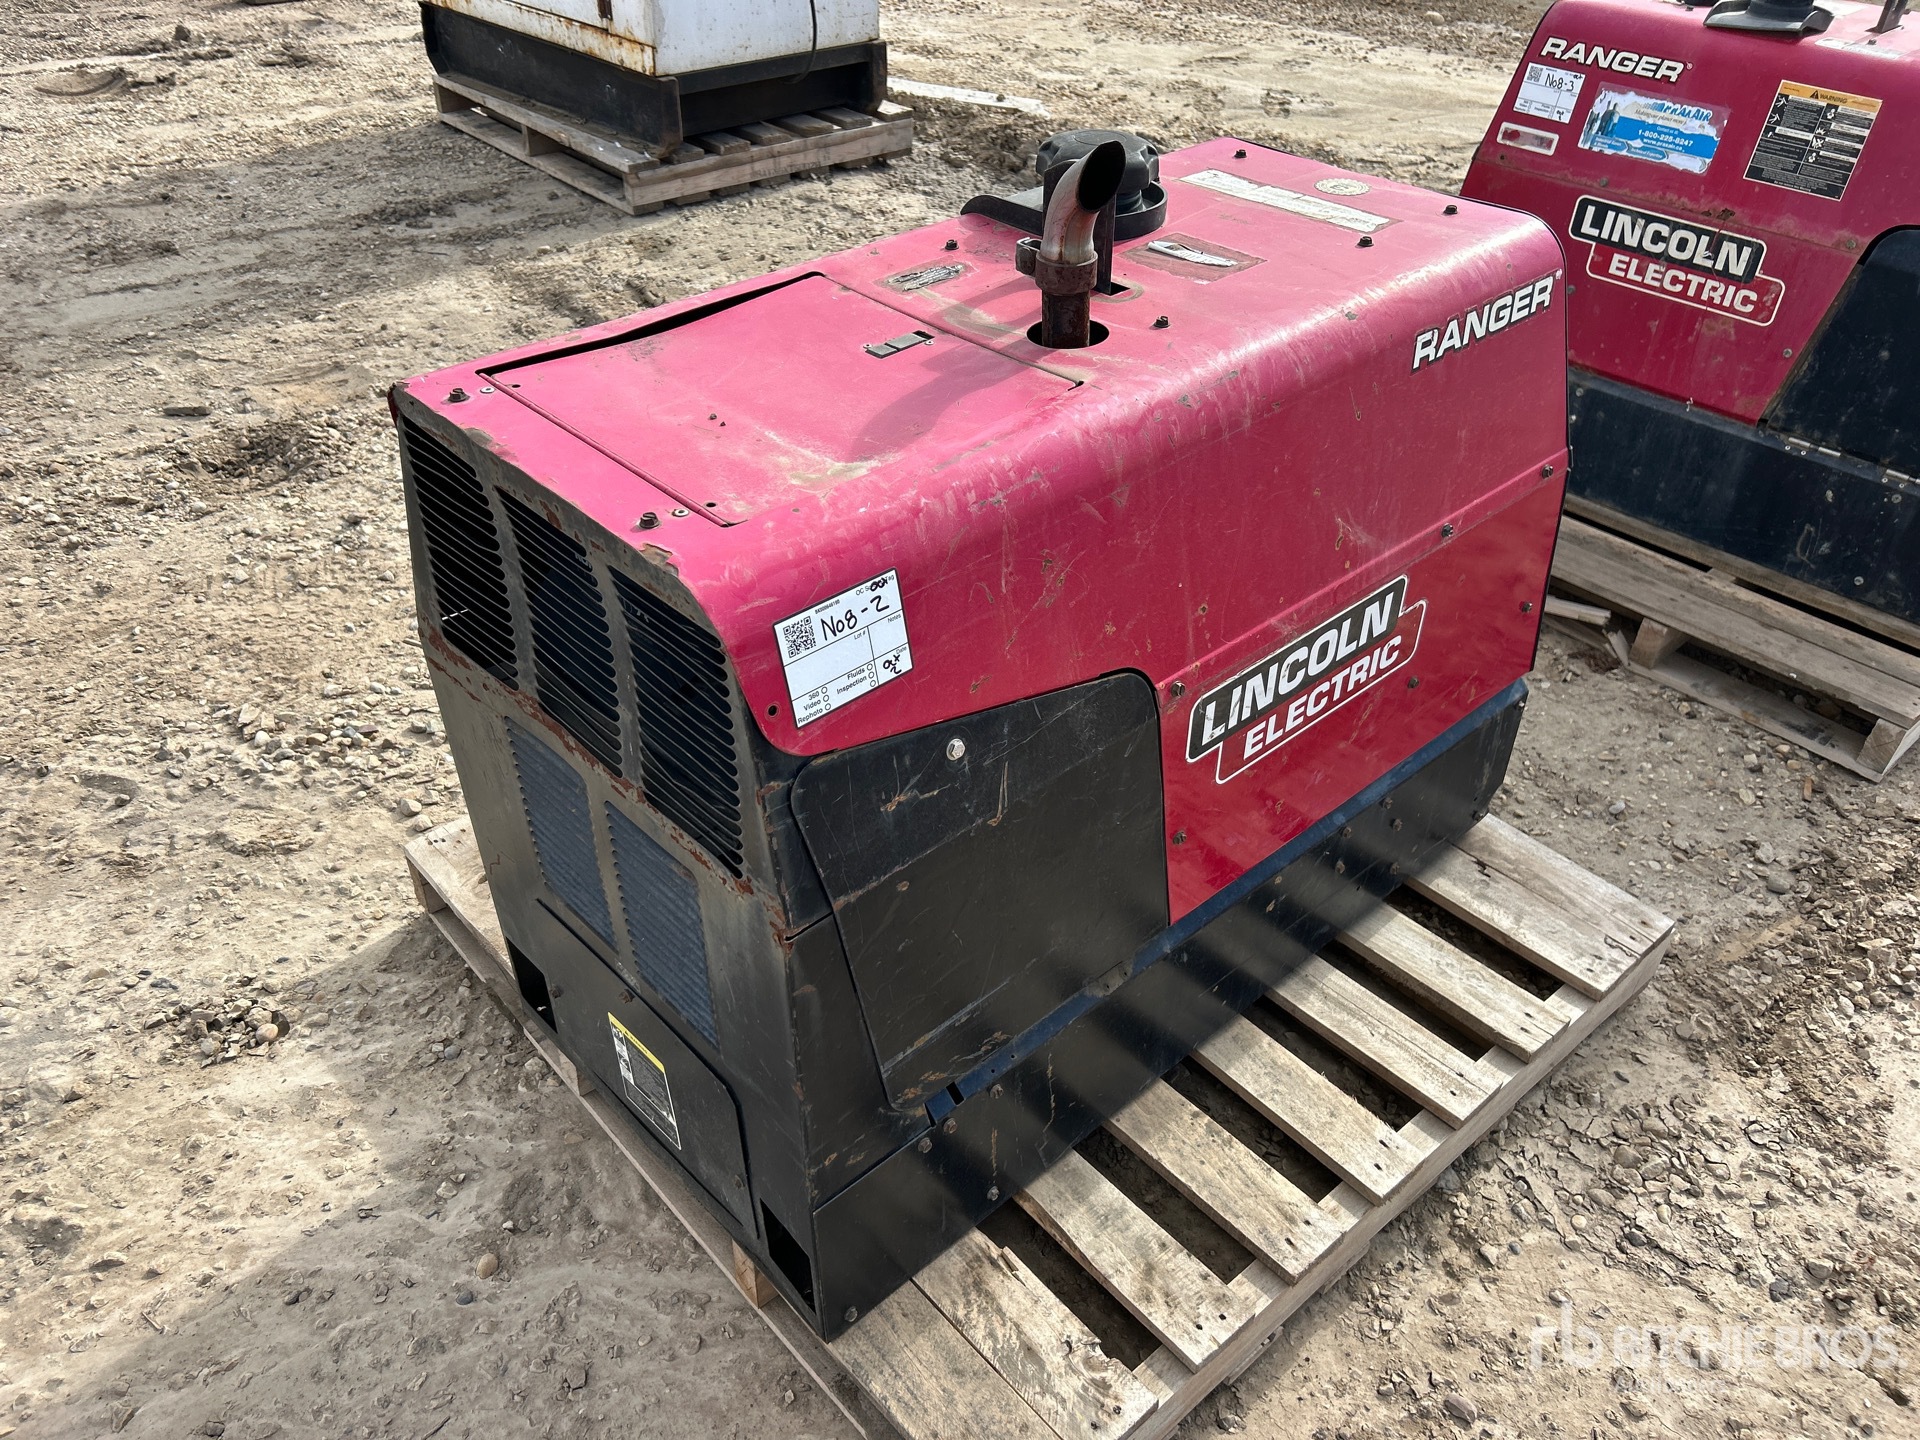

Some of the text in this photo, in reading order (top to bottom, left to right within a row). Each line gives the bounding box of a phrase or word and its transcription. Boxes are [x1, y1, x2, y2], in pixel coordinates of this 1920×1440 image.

[1540, 37, 1684, 83] RANGER
[1580, 205, 1752, 276] LINCOLN
[1608, 252, 1758, 313] ELECTRIC
[1412, 276, 1554, 369] RANGER
[887, 613, 901, 623] Notes
[836, 675, 867, 695] Inspection
[847, 668, 866, 681] Fluids
[1201, 591, 1394, 746] LINCOLN
[797, 707, 824, 725] Rephoto
[803, 699, 822, 712] Video
[1243, 635, 1401, 760] ELECTRIC
